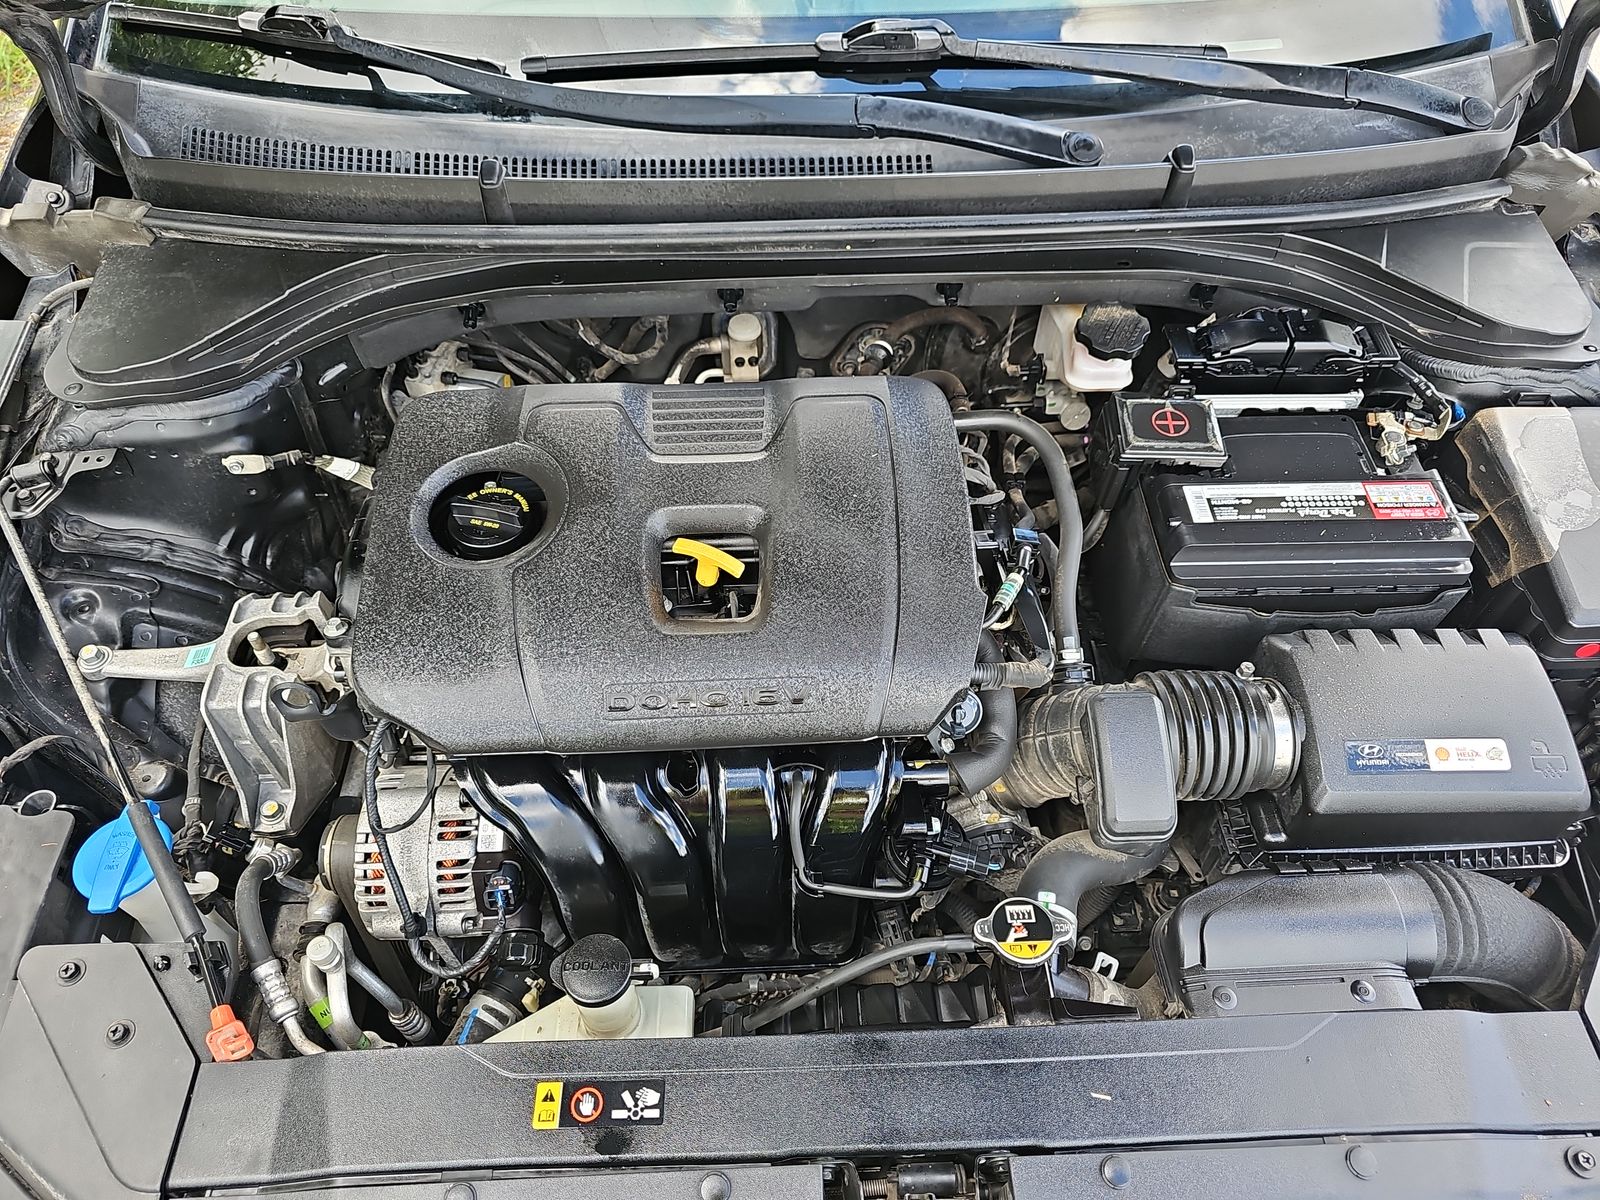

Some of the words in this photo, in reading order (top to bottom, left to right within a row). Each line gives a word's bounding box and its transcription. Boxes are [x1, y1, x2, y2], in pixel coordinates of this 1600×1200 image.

[479, 487, 514, 496] OWNER'S
[1296, 507, 1332, 518] Boys
[607, 688, 730, 712] DOHC
[740, 682, 813, 707] 16V
[1356, 758, 1389, 767] HYUNDAI
[1054, 923, 1072, 933] HCC
[563, 961, 630, 972] COOLANT
